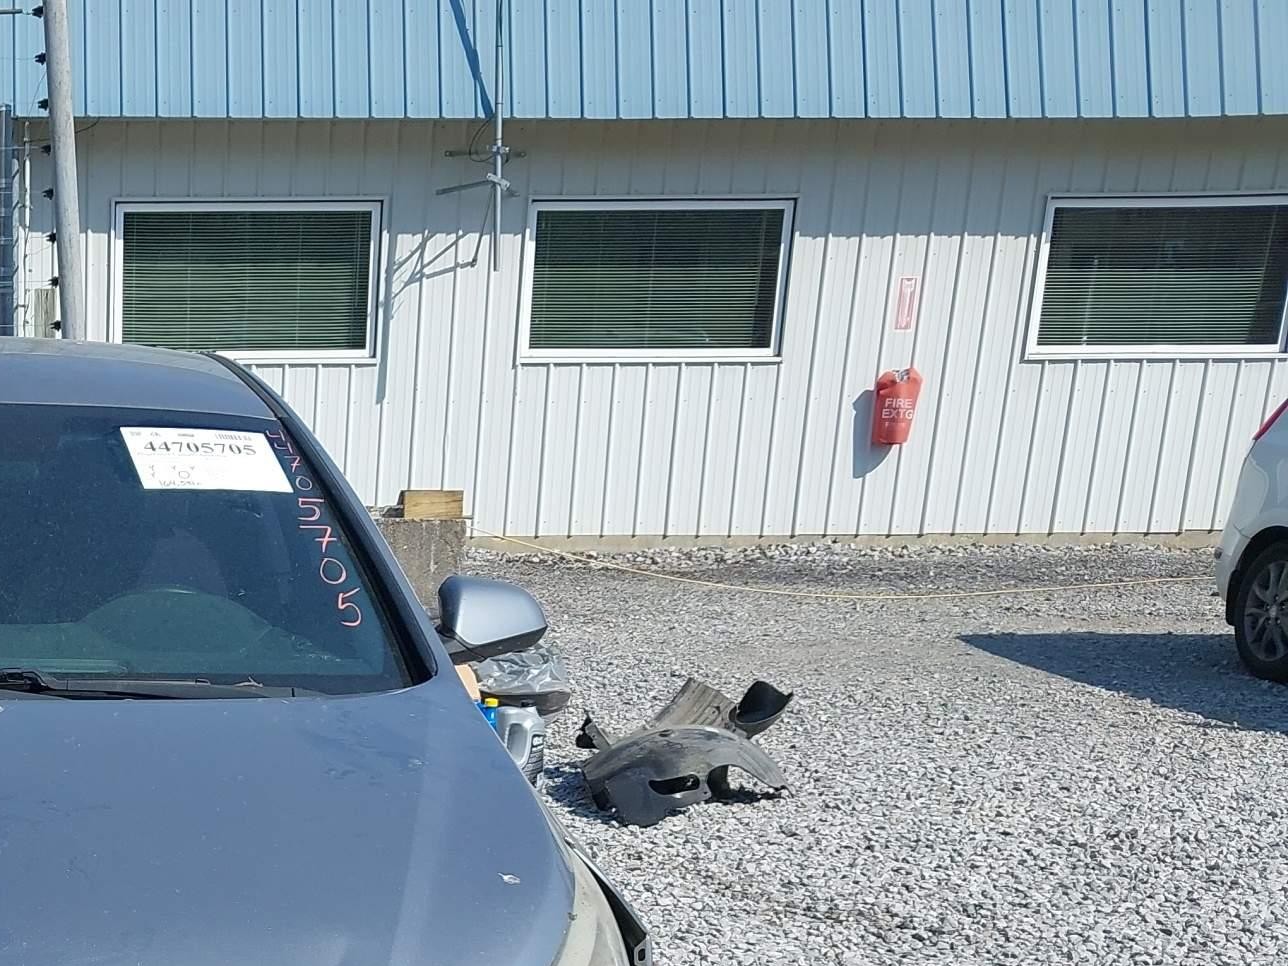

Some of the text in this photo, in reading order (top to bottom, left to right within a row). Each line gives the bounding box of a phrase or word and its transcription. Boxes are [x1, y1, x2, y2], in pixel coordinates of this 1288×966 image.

[885, 398, 913, 408] FIRE
[882, 408, 914, 420] EXTG
[144, 441, 257, 456] 44705705
